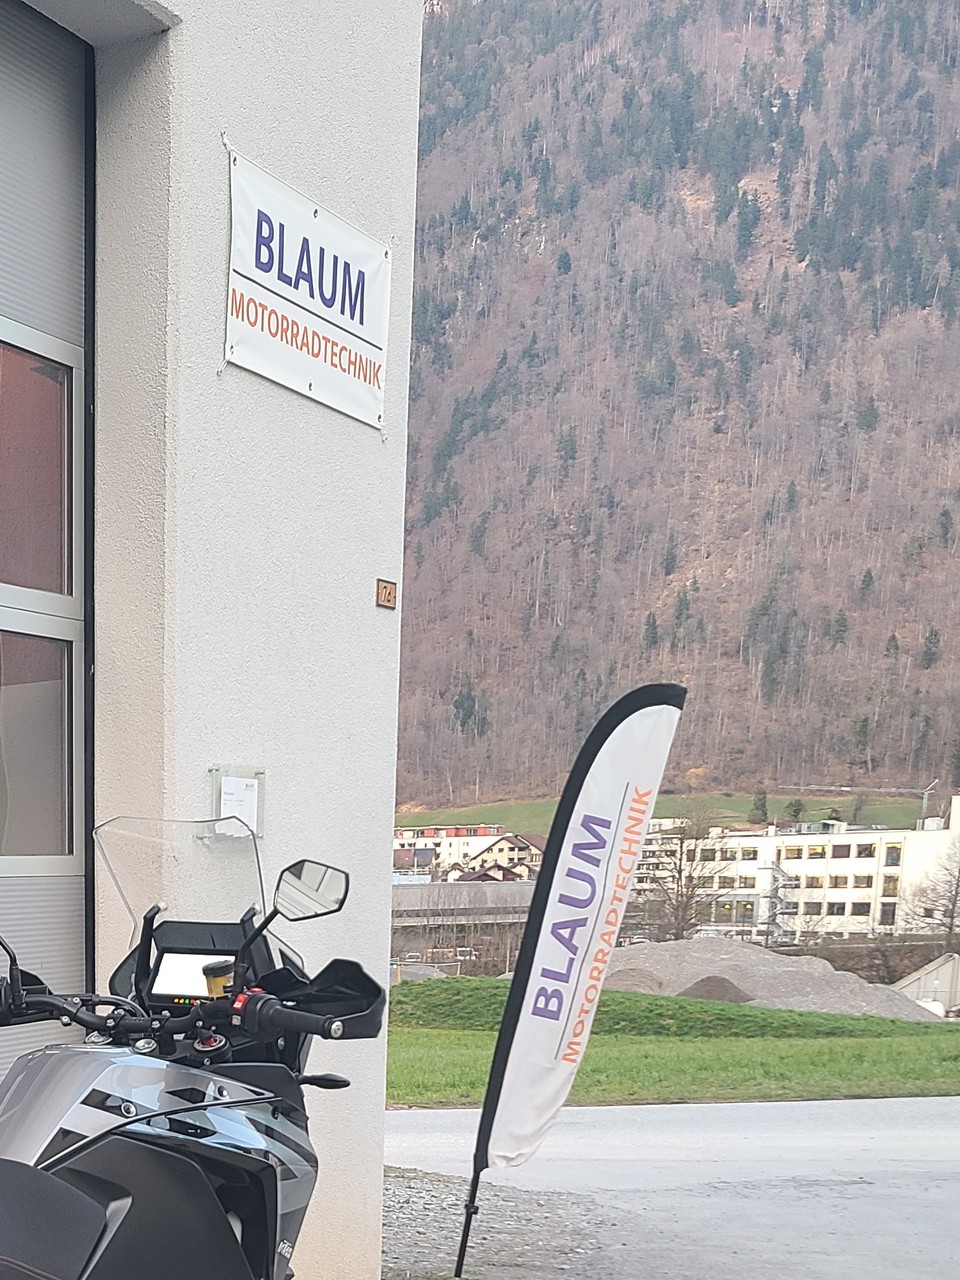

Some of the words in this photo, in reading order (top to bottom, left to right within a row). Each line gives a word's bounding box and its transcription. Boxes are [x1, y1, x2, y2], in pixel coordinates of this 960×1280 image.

[230, 287, 382, 390] MOTORRADTECHNIK
[255, 208, 366, 327] BLAUM
[531, 813, 612, 1021] BLAUM
[561, 786, 653, 1064] MOTORRADTECHNIK
